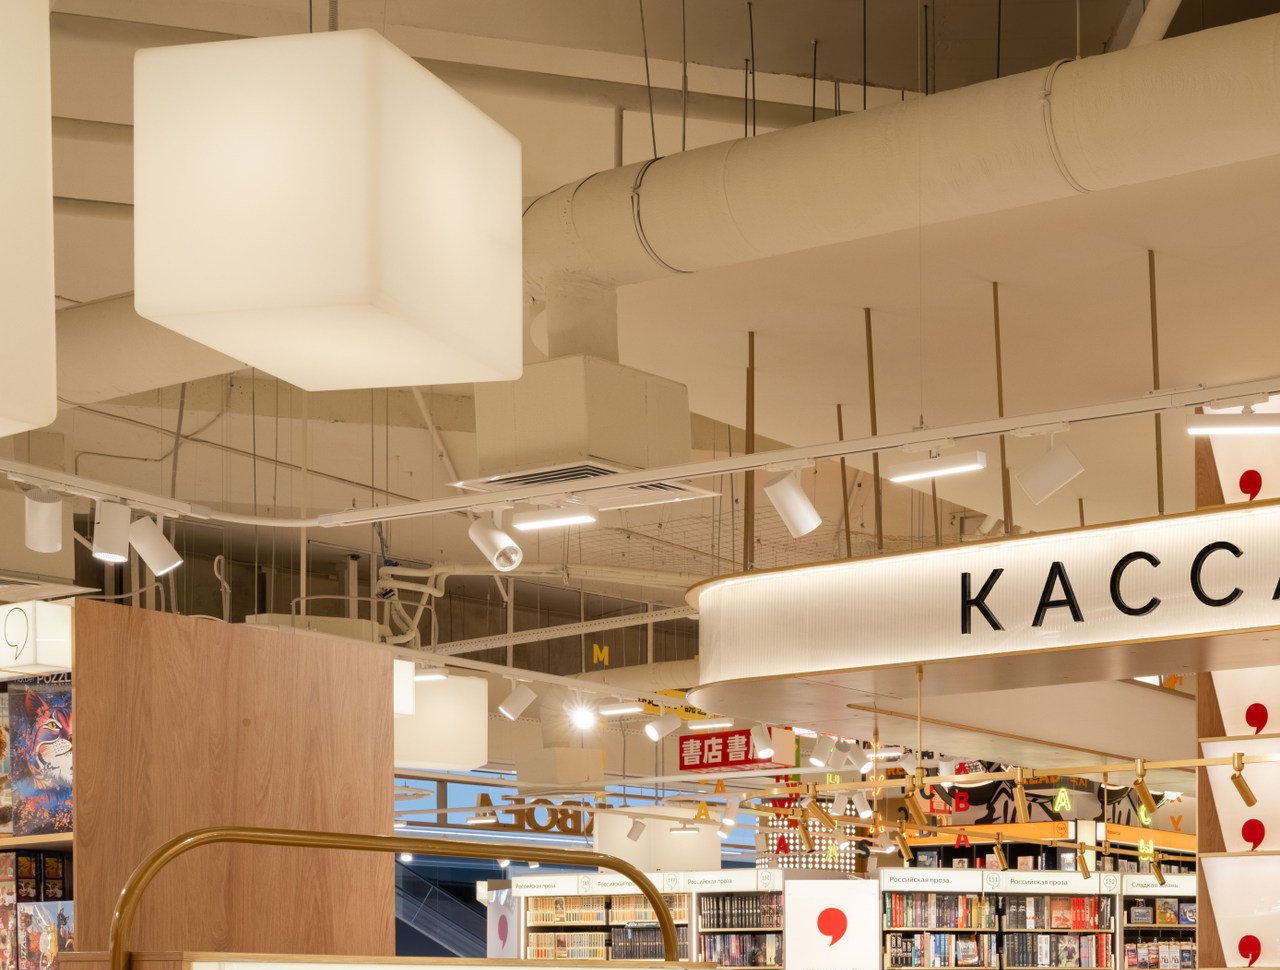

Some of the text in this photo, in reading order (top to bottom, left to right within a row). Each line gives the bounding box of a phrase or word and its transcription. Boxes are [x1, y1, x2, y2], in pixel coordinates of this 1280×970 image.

[37, 671, 72, 684] PUZZL
[889, 876, 950, 885] Российская проза
[1010, 878, 1068, 887] Российская проза
[1131, 881, 1159, 890] Сладкая
